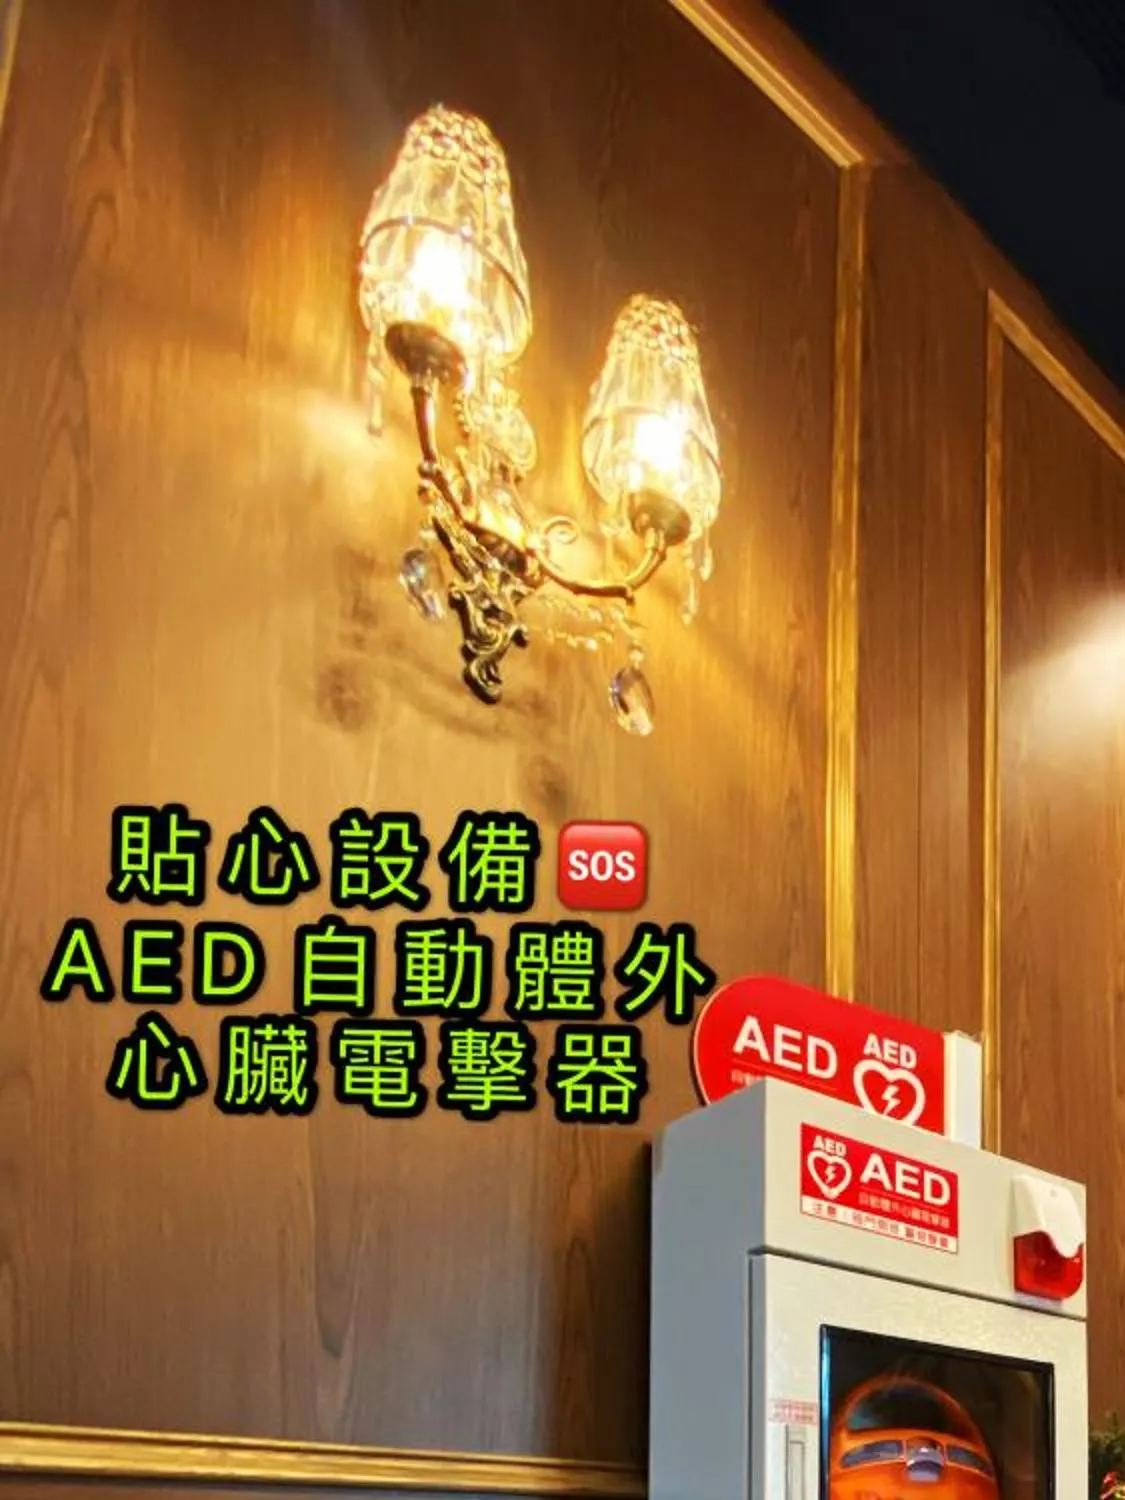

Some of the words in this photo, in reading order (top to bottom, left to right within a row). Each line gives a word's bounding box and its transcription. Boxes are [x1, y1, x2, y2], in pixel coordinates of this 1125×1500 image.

[733, 1015, 838, 1079] AED
[863, 1033, 917, 1070] AED
[813, 1135, 847, 1157] AED
[859, 1153, 951, 1206] AED
